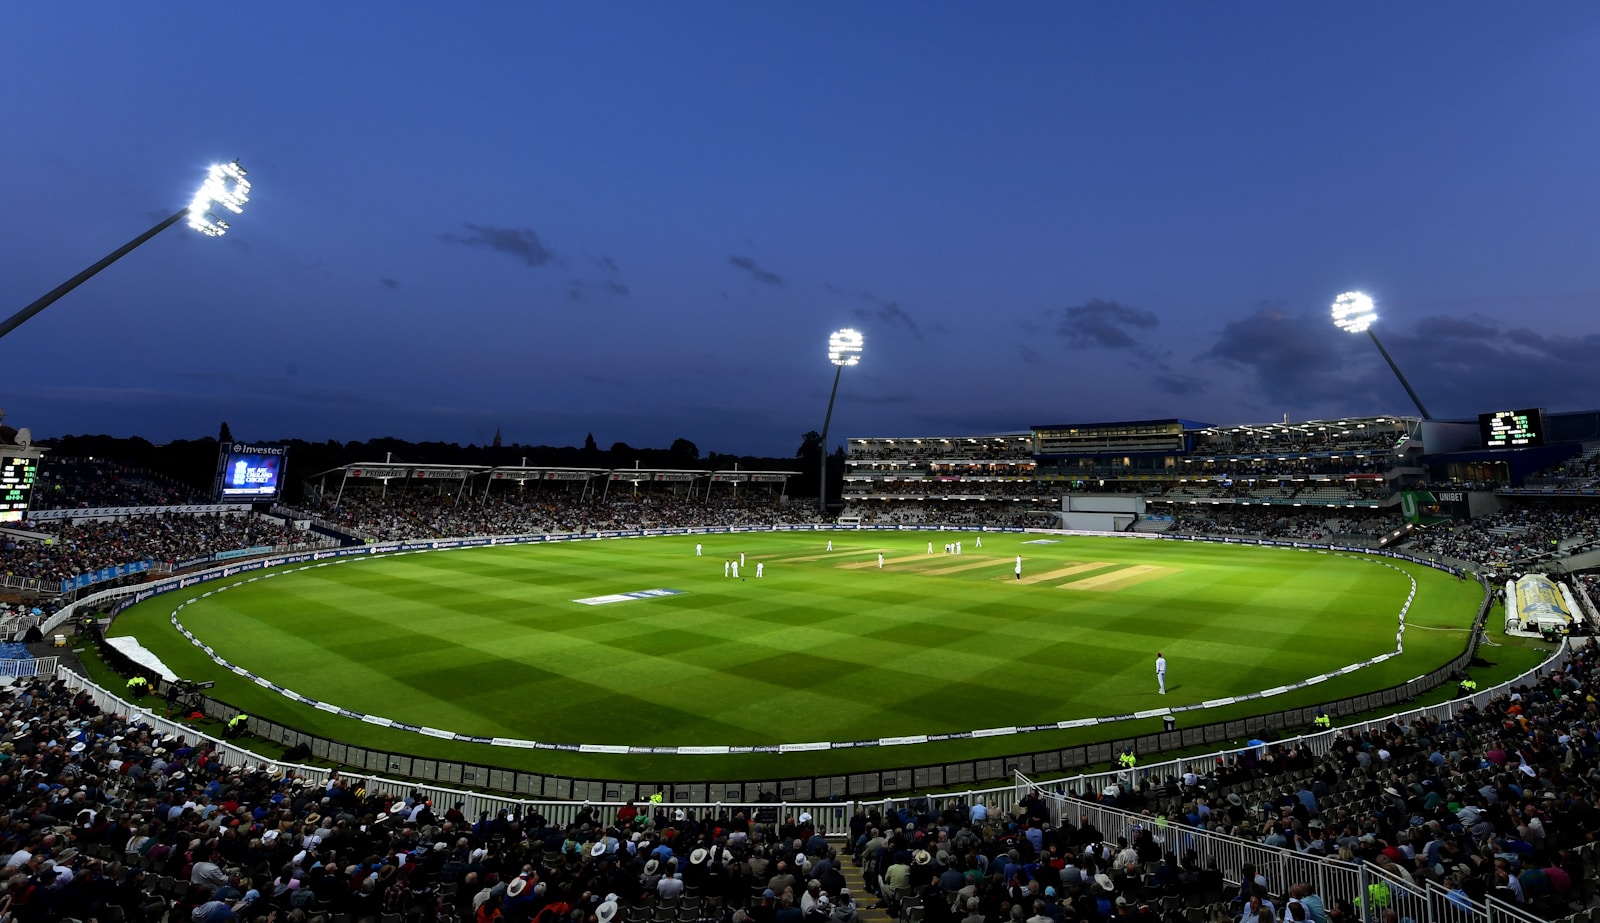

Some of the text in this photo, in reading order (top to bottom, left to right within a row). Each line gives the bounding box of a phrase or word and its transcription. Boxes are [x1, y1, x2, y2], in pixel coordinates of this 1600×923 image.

[243, 445, 282, 455] Investec
[1439, 492, 1463, 502] UNIBET
[1401, 494, 1416, 518] U
